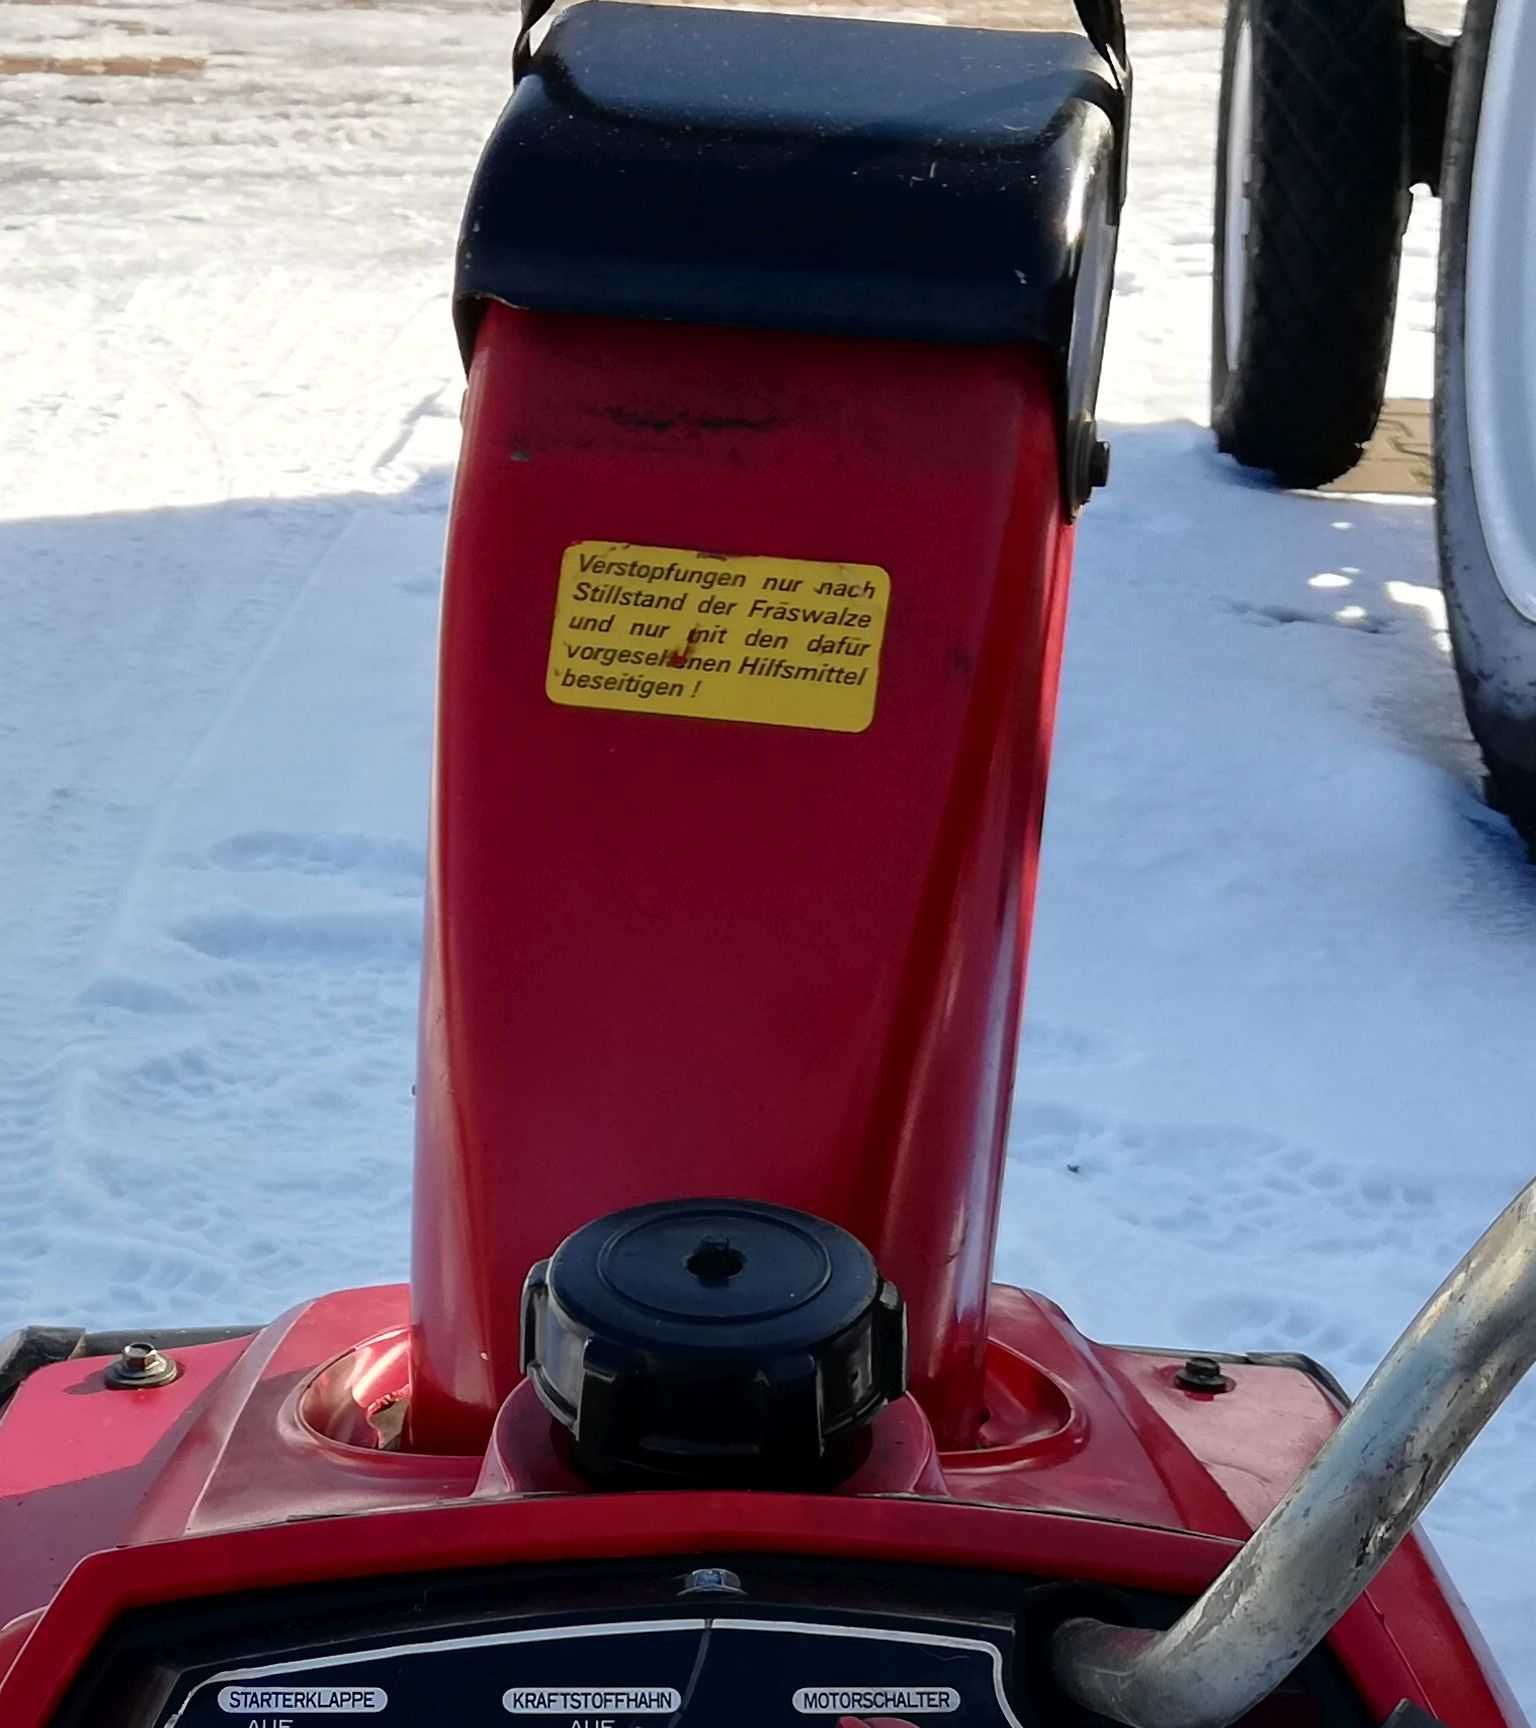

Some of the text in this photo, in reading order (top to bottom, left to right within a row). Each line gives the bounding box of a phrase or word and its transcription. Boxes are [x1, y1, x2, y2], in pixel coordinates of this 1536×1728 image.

[578, 552, 876, 600] Verstopfungen nur nach
[572, 582, 872, 629] Stillstand der Fräswalze
[568, 613, 870, 658] und nur mit den dafür
[561, 669, 702, 699] beseitigen !
[737, 656, 869, 687] Hilfsmittel
[228, 1690, 376, 1710] STARTERKLAPPE
[512, 1691, 673, 1711] KRAFTSTOFFHAHN
[803, 1691, 951, 1710] MOTORSCHALTER
